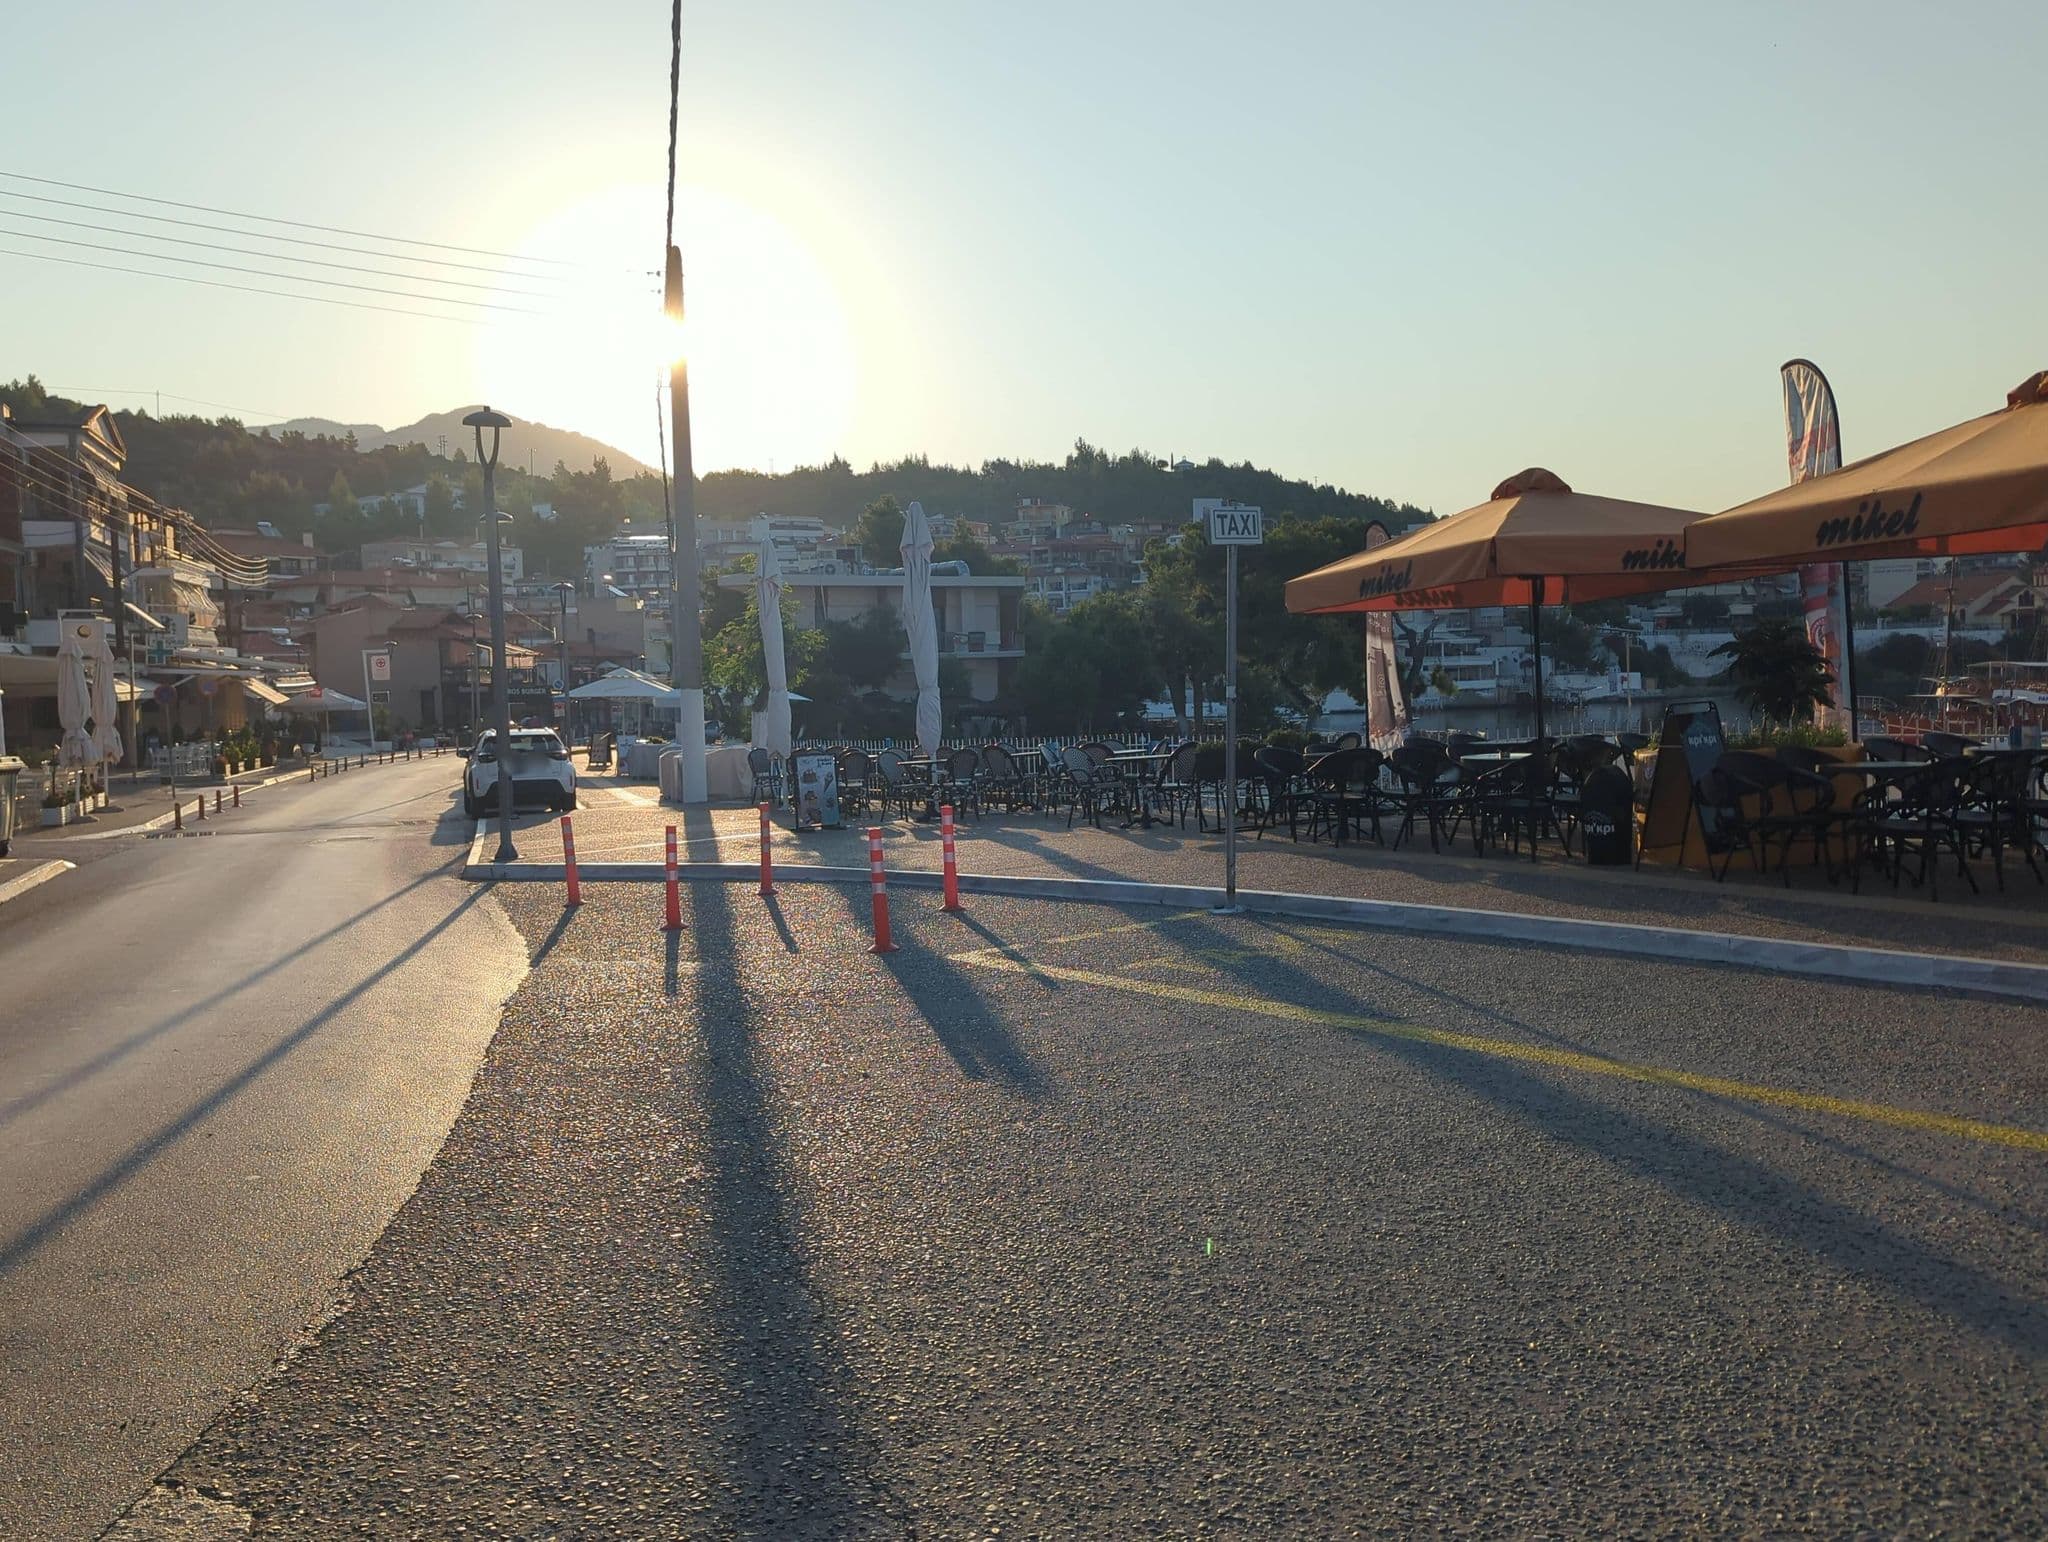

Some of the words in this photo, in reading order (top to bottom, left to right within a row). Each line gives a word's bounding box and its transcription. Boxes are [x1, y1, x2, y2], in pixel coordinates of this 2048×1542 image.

[1216, 514, 1257, 536] TAXI
[1815, 491, 1922, 546] mikel
[1359, 559, 1414, 599] mikel
